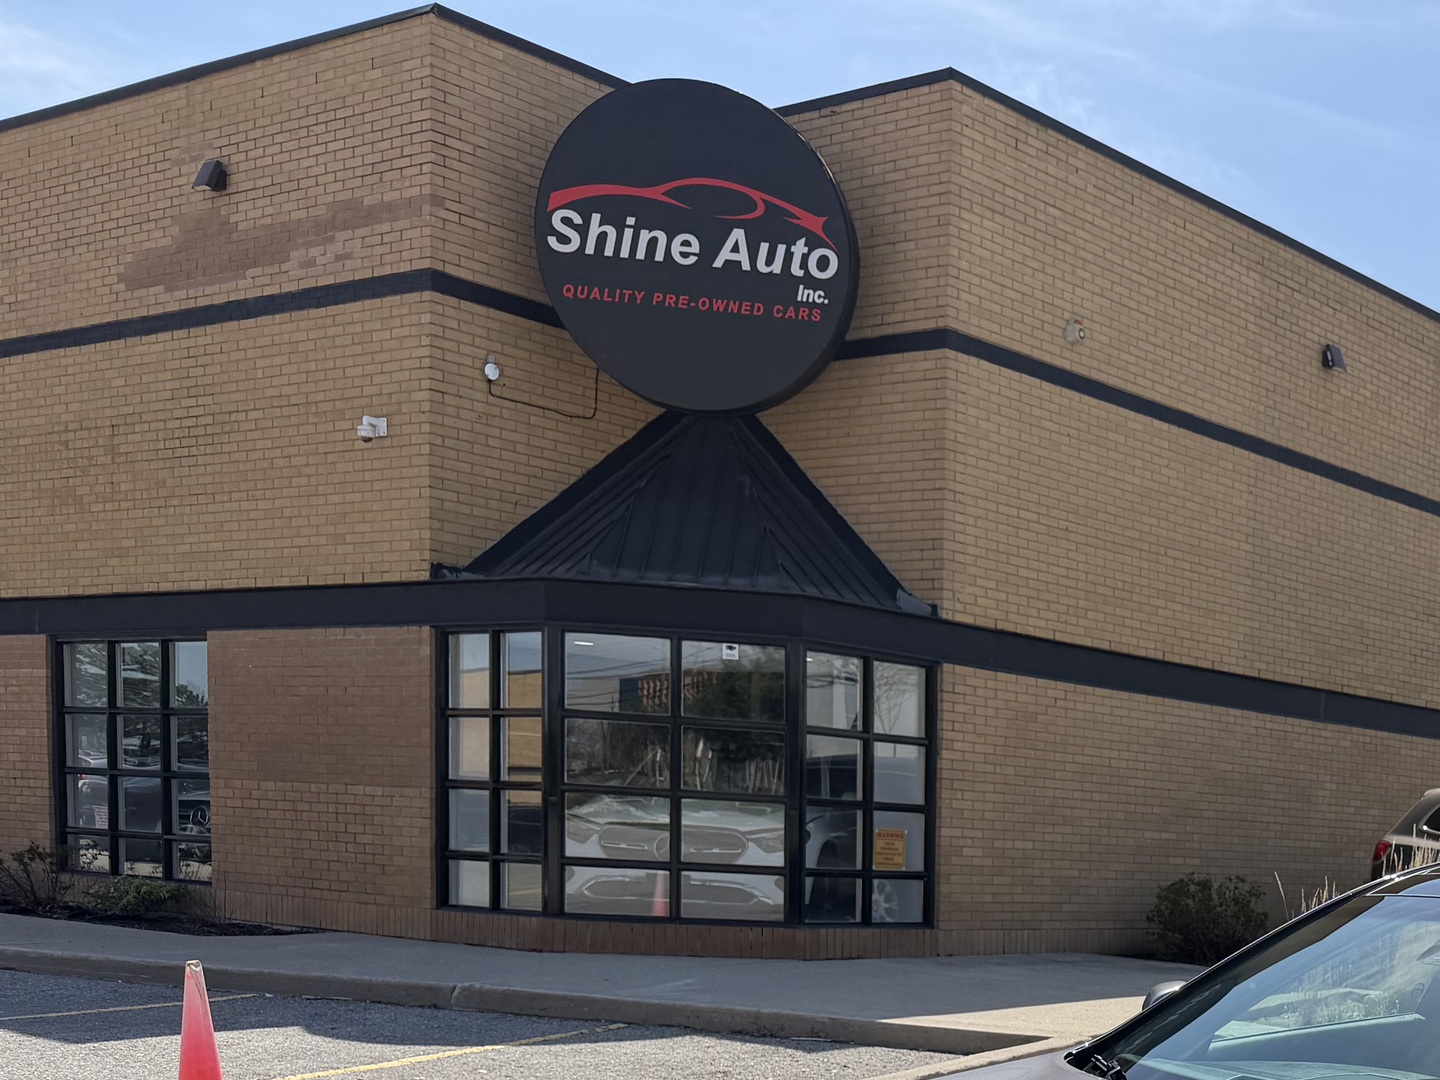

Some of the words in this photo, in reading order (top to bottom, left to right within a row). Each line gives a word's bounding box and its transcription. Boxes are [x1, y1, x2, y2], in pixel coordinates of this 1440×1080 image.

[547, 209, 700, 266] Shine
[712, 228, 839, 280] Auto
[562, 284, 645, 304] QUALITY
[653, 293, 764, 317] PRE-OWNED
[773, 304, 822, 322] CARS
[797, 284, 829, 305] Inc.
